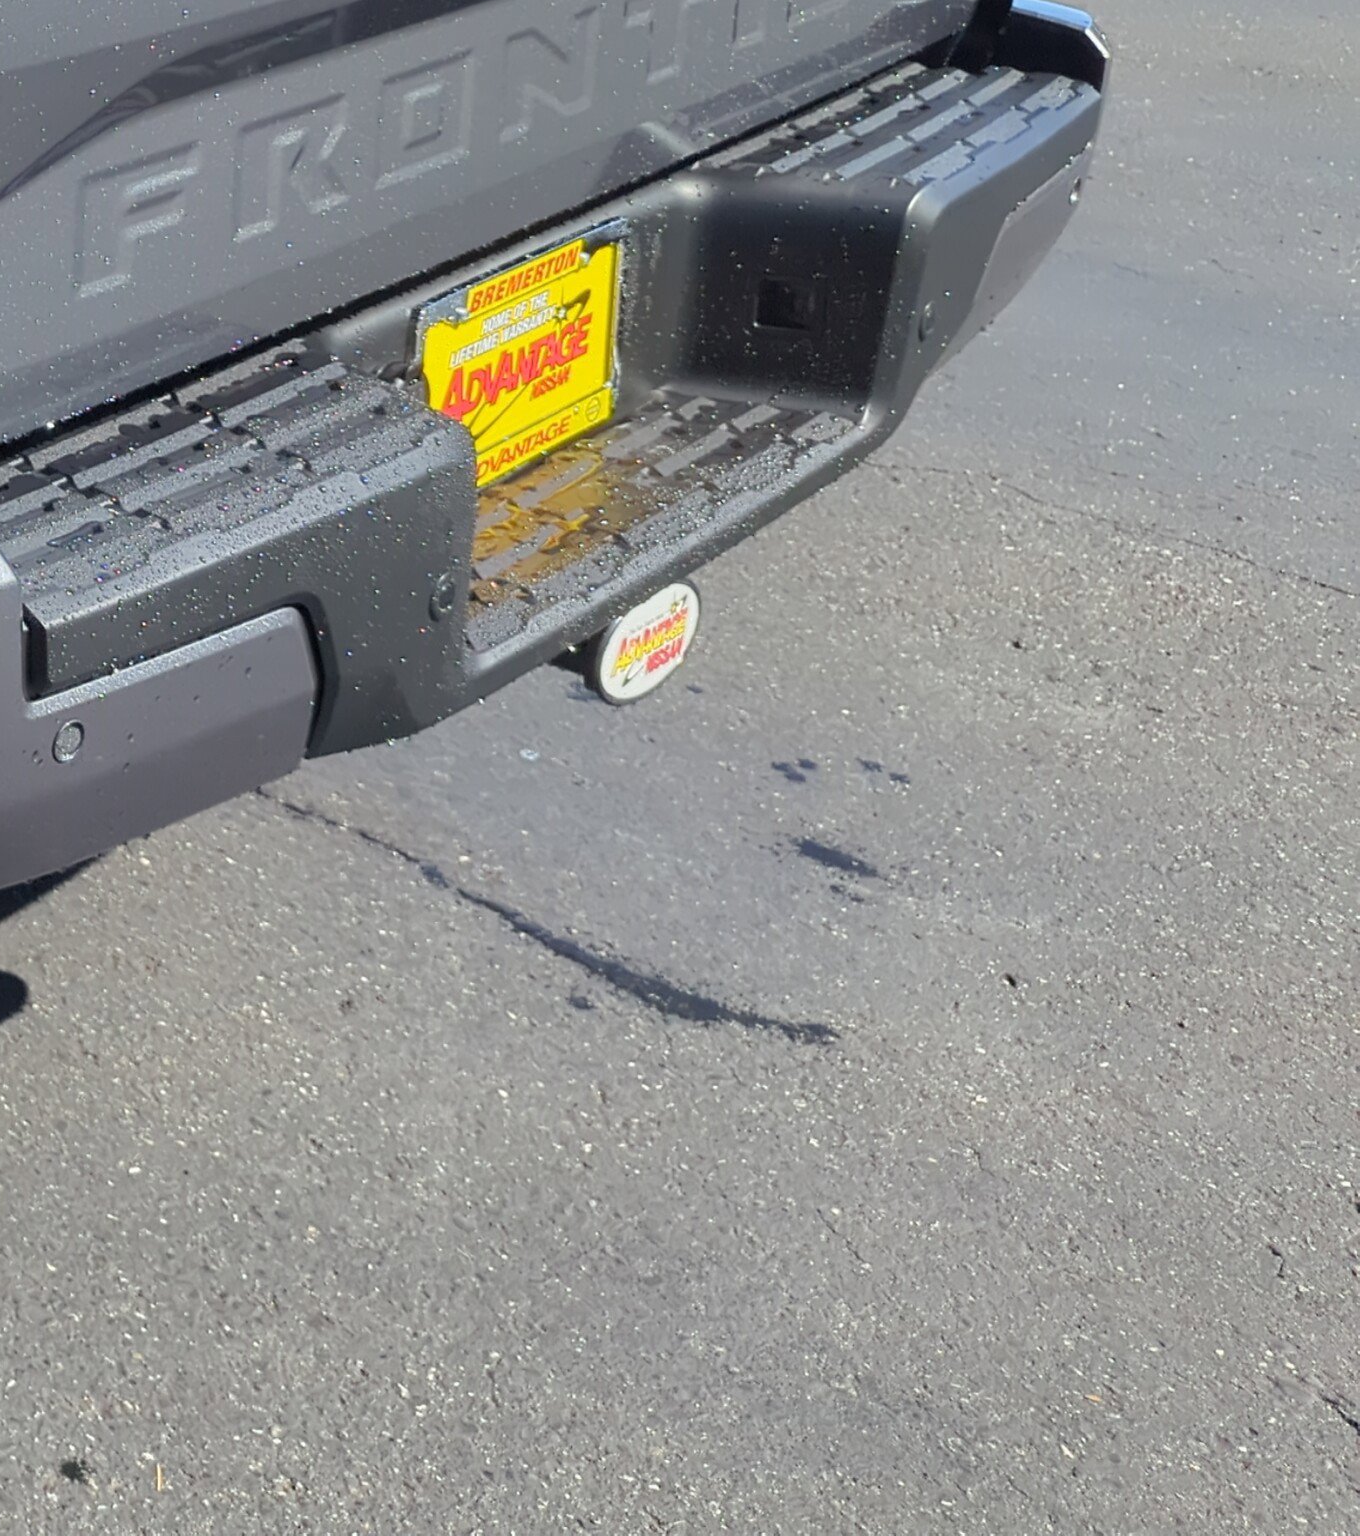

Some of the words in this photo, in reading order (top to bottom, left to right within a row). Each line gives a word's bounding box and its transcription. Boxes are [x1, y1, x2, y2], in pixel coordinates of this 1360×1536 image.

[468, 246, 579, 313] BREMERTON
[450, 335, 499, 369] LIFETIME
[500, 304, 558, 344] WARRANTY
[482, 308, 512, 335] HOME
[514, 300, 528, 321] OF
[529, 291, 551, 311] THE
[442, 313, 592, 421] ADVANTAGE
[476, 414, 573, 479] DVANTAGE
